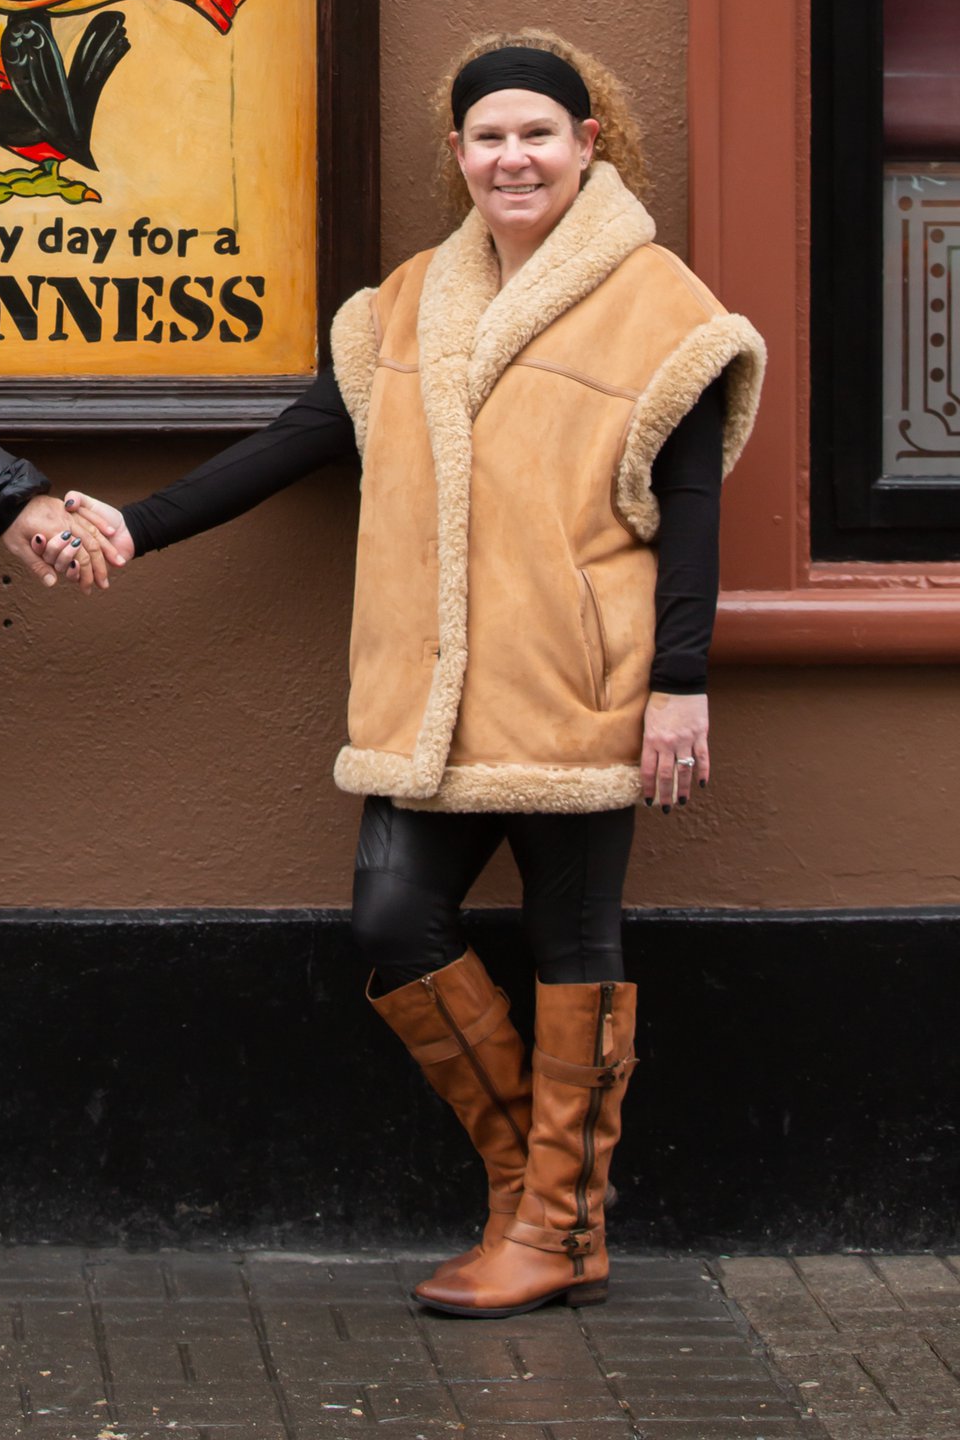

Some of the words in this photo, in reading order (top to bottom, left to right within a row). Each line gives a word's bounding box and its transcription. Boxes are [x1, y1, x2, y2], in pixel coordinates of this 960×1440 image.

[38, 216, 117, 264] day
[128, 216, 198, 257] for
[216, 227, 240, 255] a
